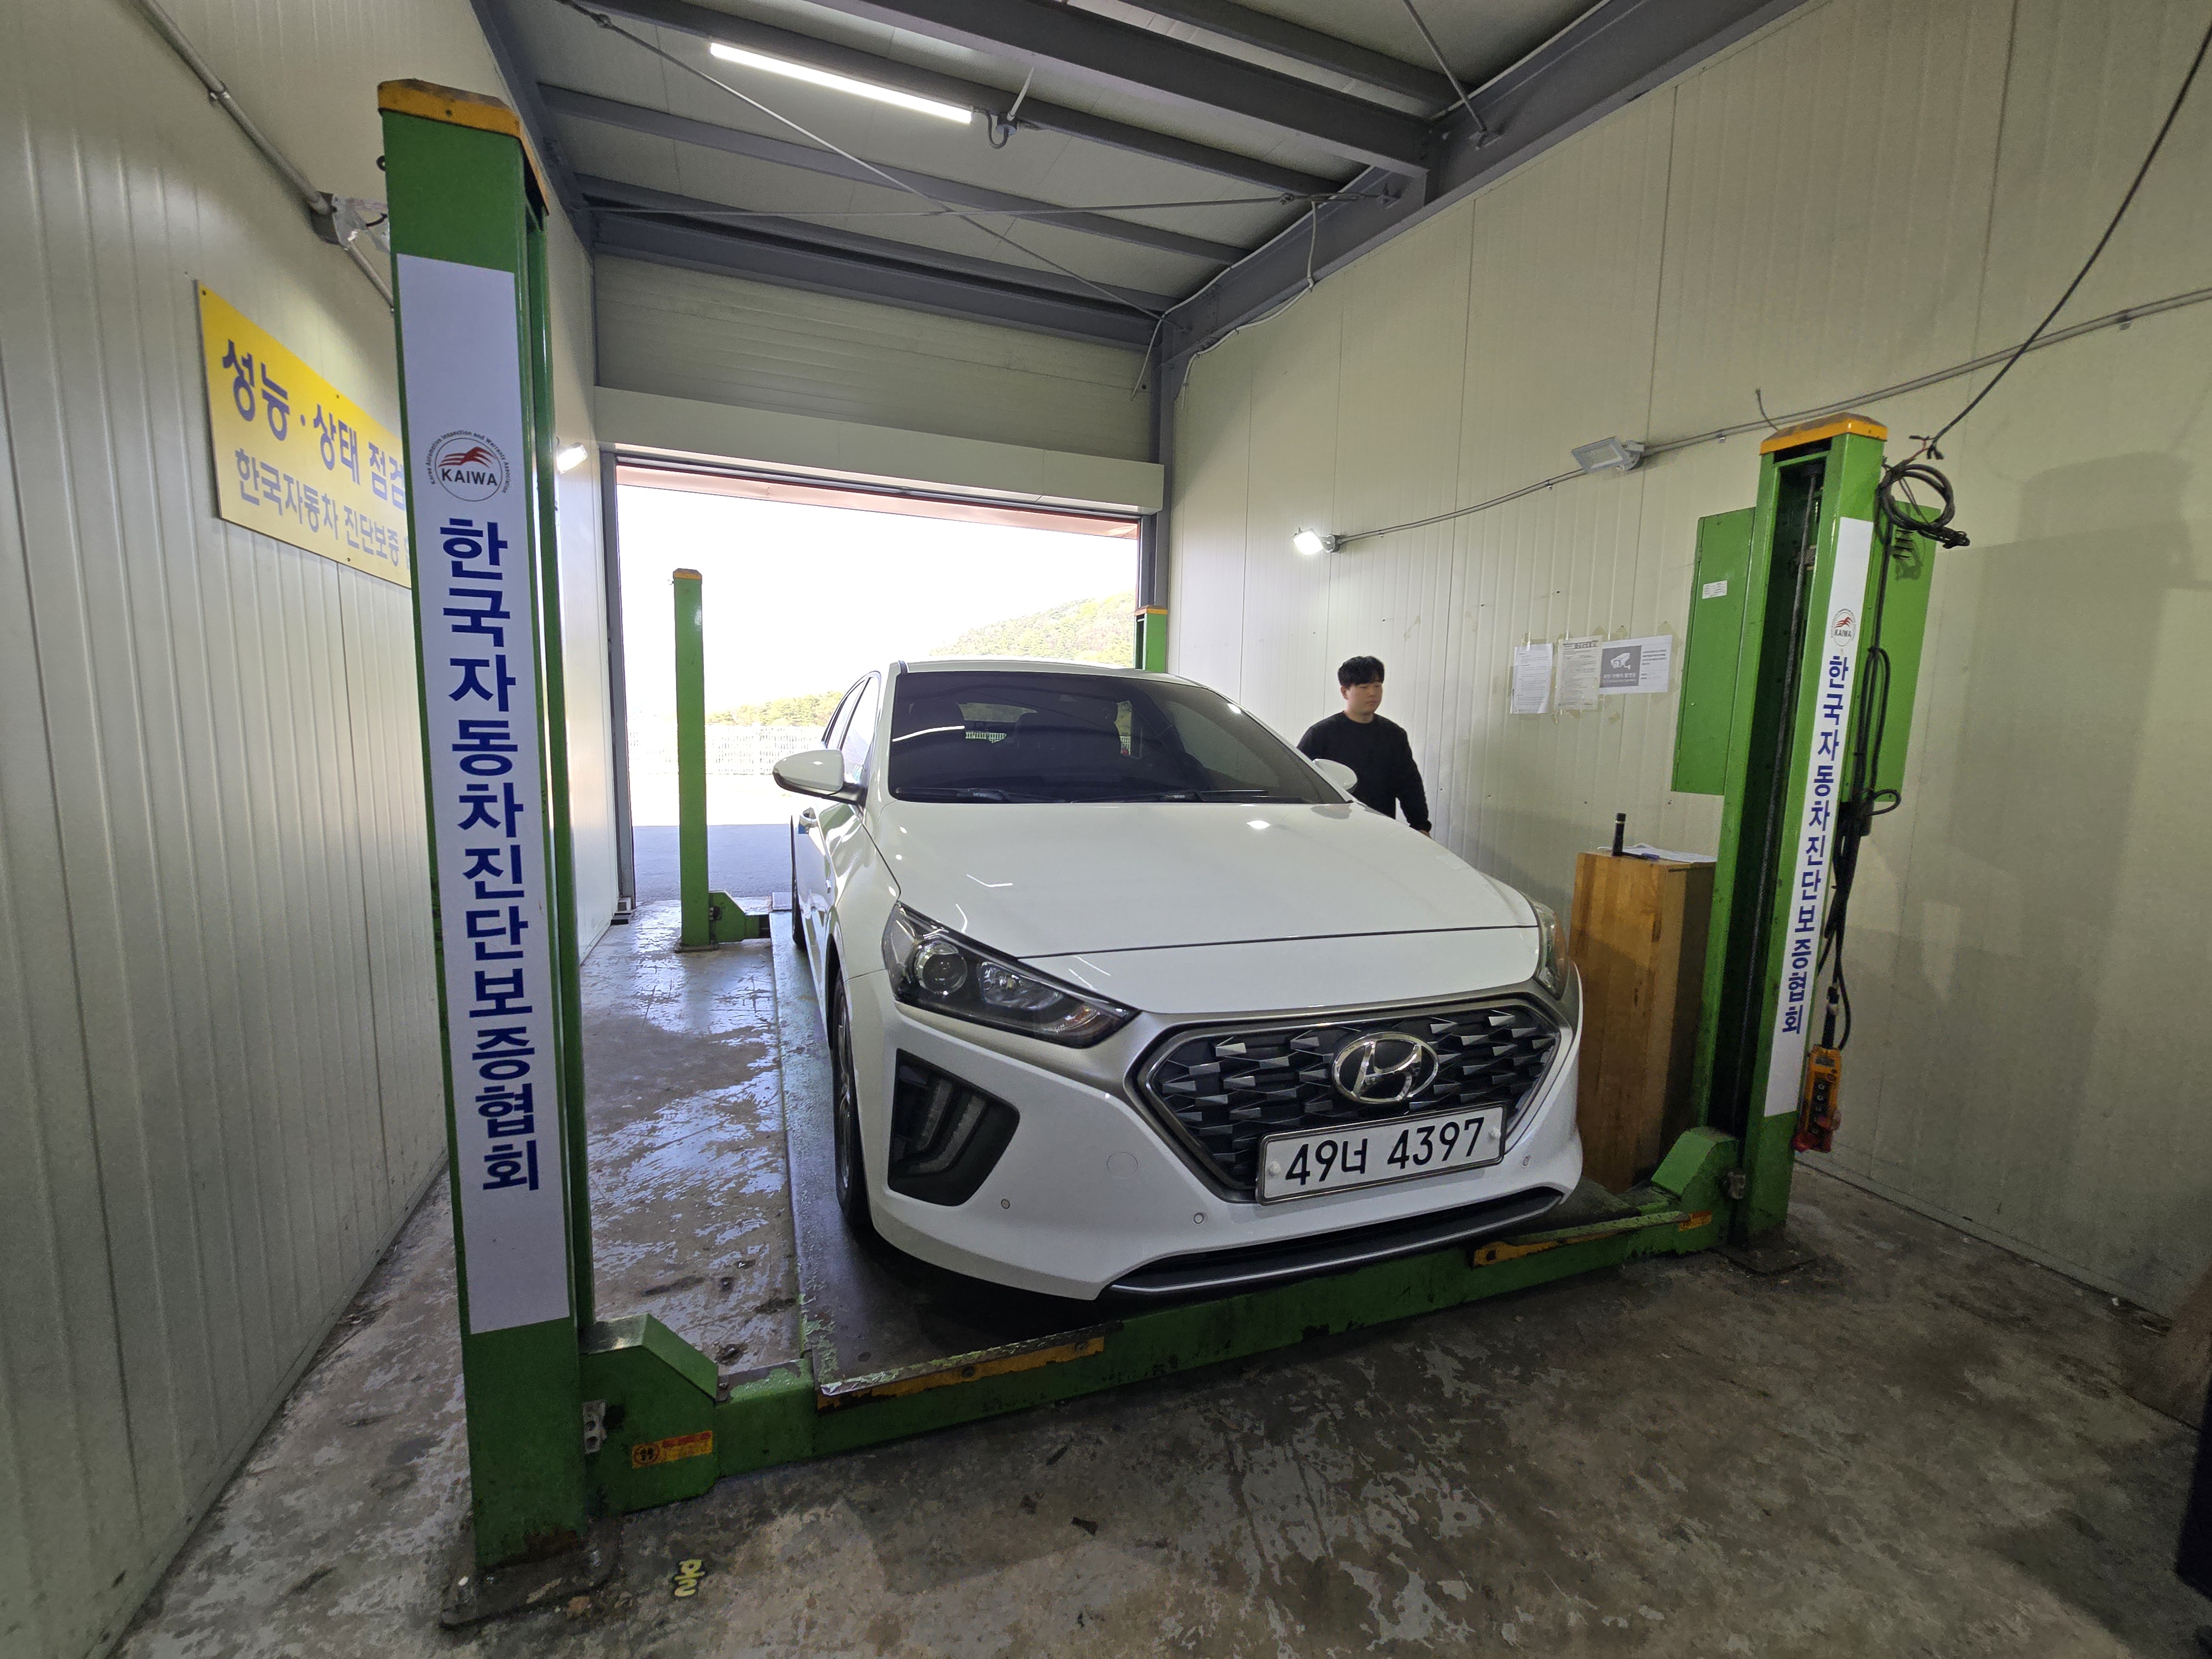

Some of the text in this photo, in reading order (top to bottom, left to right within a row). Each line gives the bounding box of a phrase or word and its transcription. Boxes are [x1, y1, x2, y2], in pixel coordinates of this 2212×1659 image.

[441, 430, 472, 440] Inspection
[486, 437, 507, 461] Warranty
[441, 468, 498, 486] KAIWA
[235, 448, 338, 540] 한국자동차
[343, 505, 400, 567] 진단보증
[1834, 629, 1851, 638] KAIWA
[1285, 1117, 1485, 1185] 49너 4397
